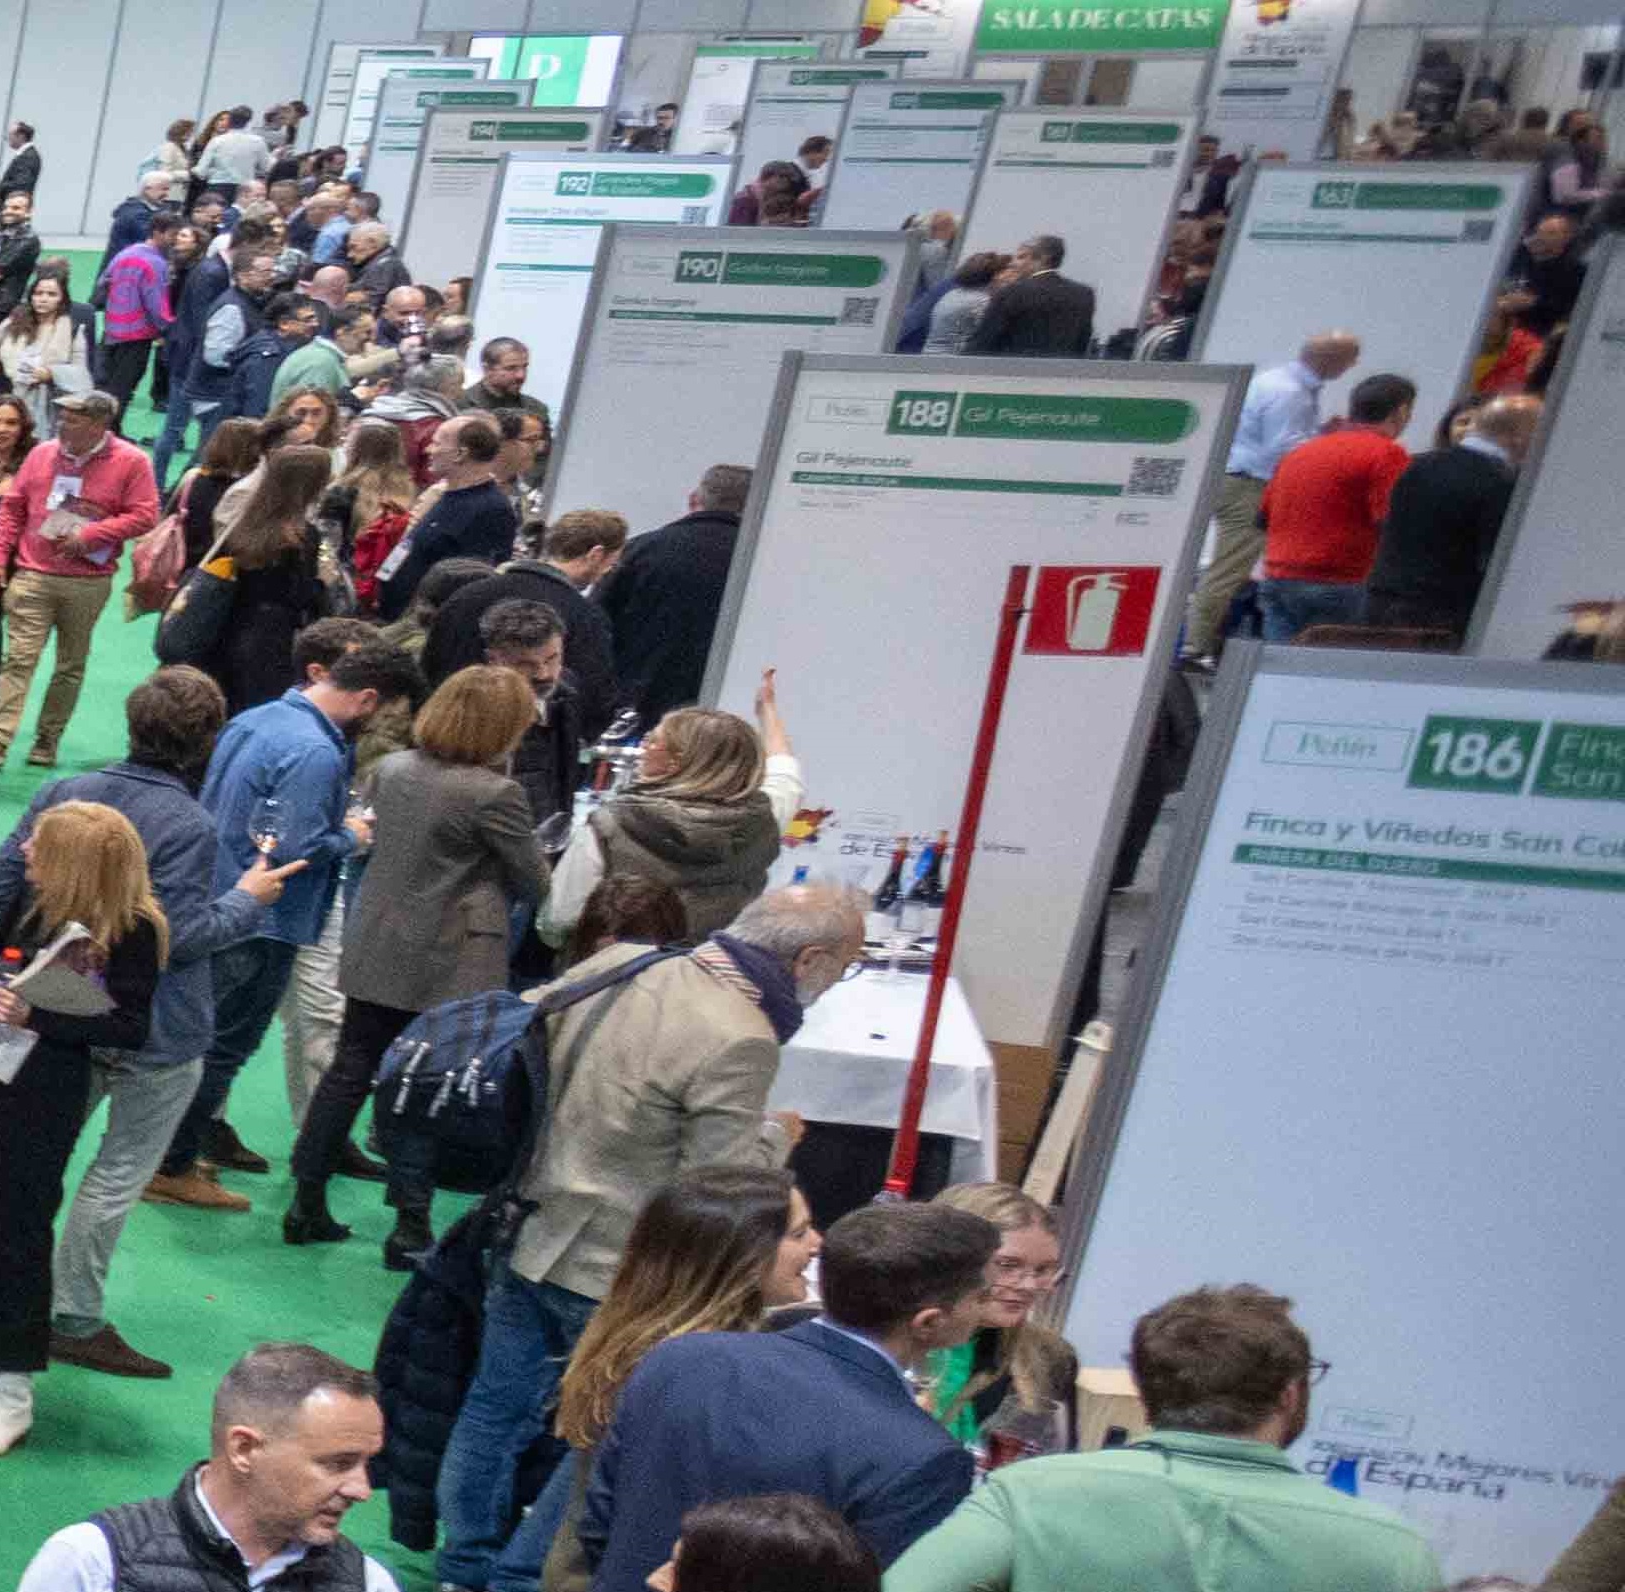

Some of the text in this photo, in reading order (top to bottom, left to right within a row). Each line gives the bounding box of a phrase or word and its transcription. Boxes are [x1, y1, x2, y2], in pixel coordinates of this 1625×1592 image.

[989, 8, 1215, 31] SALA DE CATAS
[560, 176, 588, 192] 192
[682, 258, 719, 277] 190
[897, 399, 949, 427] 188
[964, 405, 993, 423] Gil
[797, 451, 819, 465] Gil
[1427, 731, 1524, 779] 186
[1245, 811, 1563, 854] Finca y Viñedos San
[1435, 1452, 1553, 1484] Mejores
